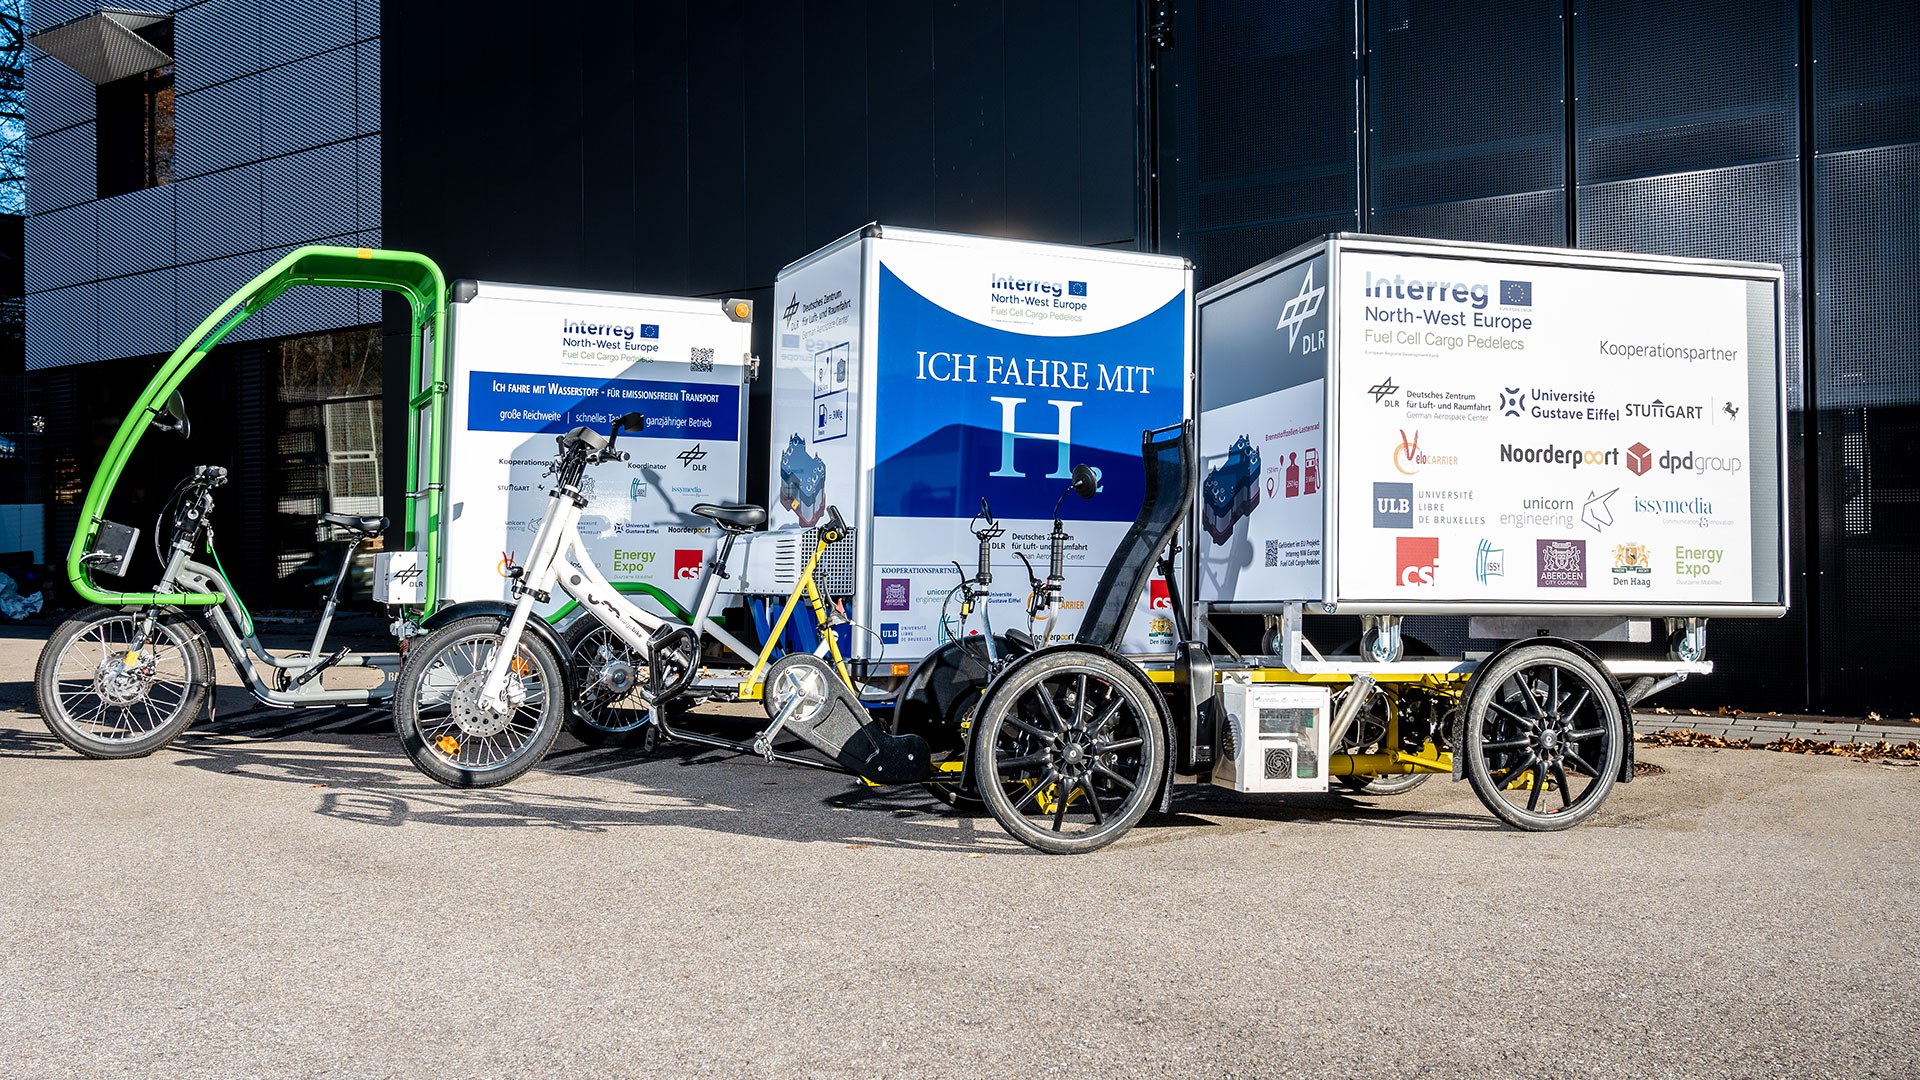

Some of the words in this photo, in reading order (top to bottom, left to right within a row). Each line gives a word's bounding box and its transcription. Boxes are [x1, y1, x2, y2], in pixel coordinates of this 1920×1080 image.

[991, 273, 1062, 297] Interreg
[1366, 271, 1488, 309] Interreg
[991, 293, 1049, 307] North-West
[1054, 298, 1087, 312] Europe
[991, 307, 1007, 316] Fuel
[1009, 308, 1024, 317] Cell
[1025, 309, 1048, 320] Cargo
[1049, 311, 1082, 322] Pedelecs
[1365, 306, 1466, 326] North-West
[1473, 312, 1532, 332] Europe
[563, 318, 635, 340] Interreg
[562, 338, 621, 350] North-West
[625, 342, 659, 353] Europe
[1303, 329, 1325, 355] DLR
[1365, 329, 1392, 343] Fuel
[1396, 330, 1420, 345] Cell
[1425, 332, 1464, 350] Cargo
[1467, 334, 1524, 350] Pedelecs
[562, 350, 578, 360] Fuel
[580, 351, 596, 360] Cell
[597, 352, 620, 364] Cargo
[1600, 340, 1738, 362] Kooperationspartner
[916, 351, 978, 383] ICH
[986, 356, 1089, 390] FAHRE
[1096, 364, 1154, 394] MIT
[1406, 390, 1444, 400] Deutsches
[1445, 392, 1476, 400] Zentrum
[1531, 388, 1596, 404] Université
[1406, 400, 1418, 408] für
[1419, 401, 1436, 410] Luft-
[1438, 402, 1452, 410] und
[1454, 402, 1492, 412] Raumfahrt
[1531, 406, 1584, 420] Gustave
[1587, 408, 1620, 421] Eiffel
[1626, 398, 1703, 419] STUTTGART
[500, 410, 521, 422] große
[523, 410, 562, 422] Reichweite
[576, 413, 606, 424] schnelles
[646, 416, 687, 428] ganzjähriger
[688, 418, 712, 428] Betrieb
[1434, 412, 1466, 422] Aerospace
[1468, 414, 1488, 422] Center
[1500, 444, 1619, 469] Noorderpoort
[1659, 450, 1741, 475] dpdgroup
[1418, 490, 1474, 500] UNIVERSITÉ
[1377, 498, 1410, 514] ULB
[1418, 504, 1444, 512] LIBRE
[1523, 496, 1574, 510] unicorn
[1634, 496, 1712, 514] issymedia
[1418, 516, 1430, 524] DE
[1434, 516, 1486, 524] BRUXELLES
[1500, 510, 1573, 530] engineering
[668, 526, 711, 535] Noorderpoort
[1012, 533, 1045, 541] Deutsches
[614, 550, 656, 562] Energy
[1676, 546, 1724, 563] Energy
[614, 561, 644, 573] Expo
[1676, 562, 1710, 578] Expo
[1540, 572, 1584, 580] ABERDEEN
[1630, 578, 1651, 588] Haag
